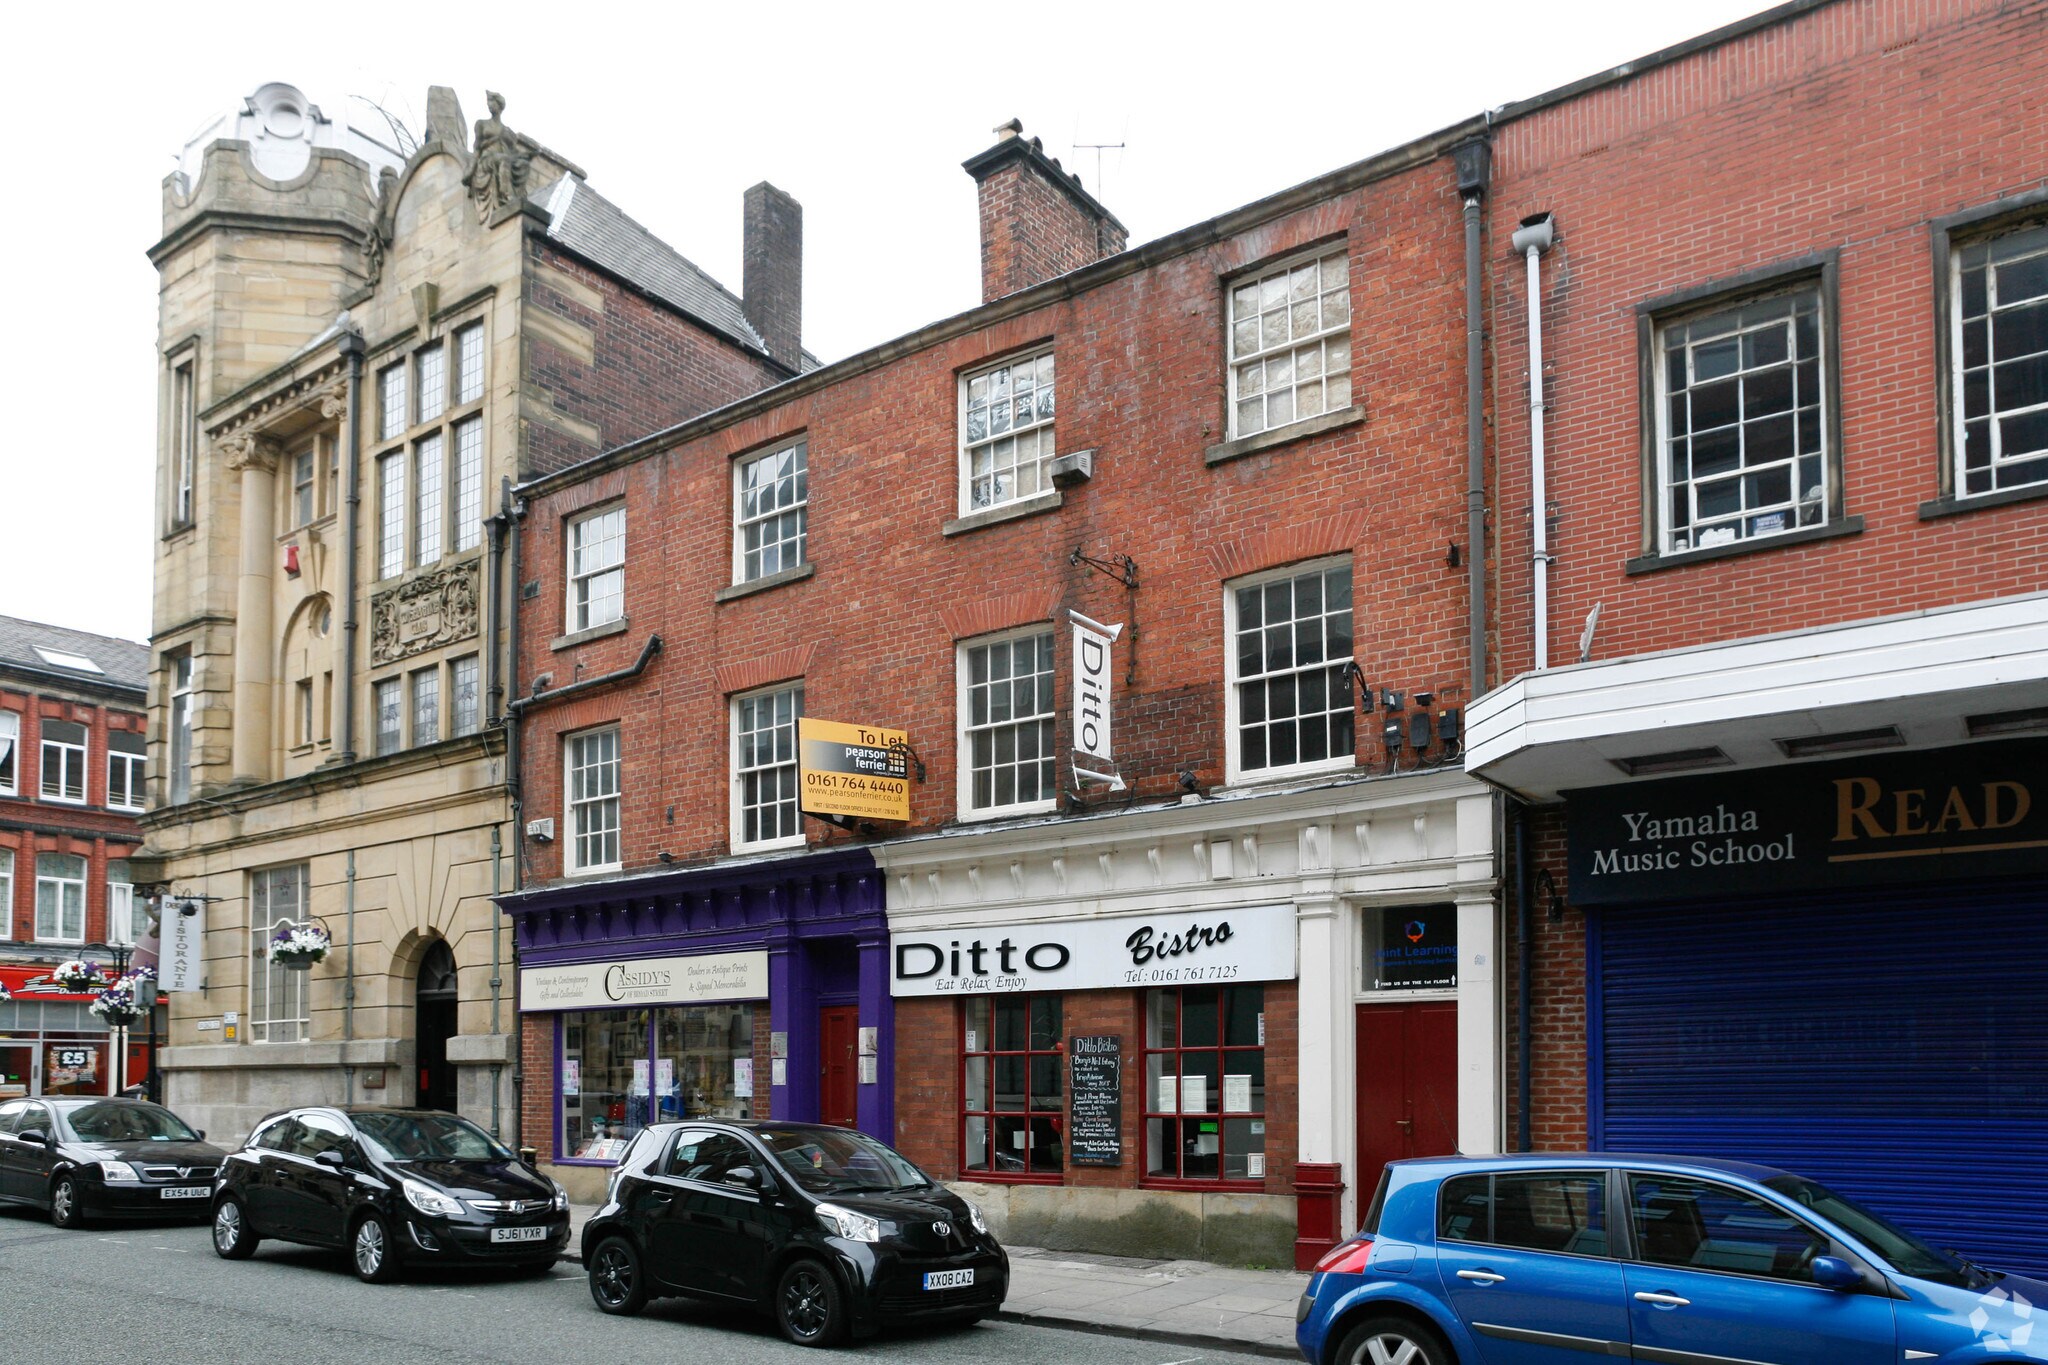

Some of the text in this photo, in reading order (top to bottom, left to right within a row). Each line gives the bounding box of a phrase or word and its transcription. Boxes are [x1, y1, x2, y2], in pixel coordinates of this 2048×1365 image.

[1082, 637, 1103, 752] Ditto
[858, 729, 904, 747] To Let
[845, 747, 886, 759] pearson
[855, 757, 887, 770] ferrier
[807, 773, 903, 794] 0161 764 4440
[808, 787, 903, 803] www.pearsonferrier.co.uk
[1830, 777, 2032, 841] READ
[1622, 804, 1759, 842] Yamaha
[1590, 833, 1796, 876] Music School
[1125, 921, 1234, 965] Bistro
[896, 938, 1070, 979] Ditto
[1152, 969, 1179, 981] 0161
[1183, 966, 1204, 980] 761
[1208, 965, 1238, 979] 7125
[935, 974, 1027, 992] Eat Relax Enjoy
[846, 1044, 854, 1059] 7
[1076, 1037, 1117, 1053] Ditto Bistro
[62, 1051, 85, 1065] £5
[164, 1188, 188, 1197] EX54
[498, 1227, 541, 1239] SJ61 YXR
[930, 1271, 972, 1287] XX08 CAZ
